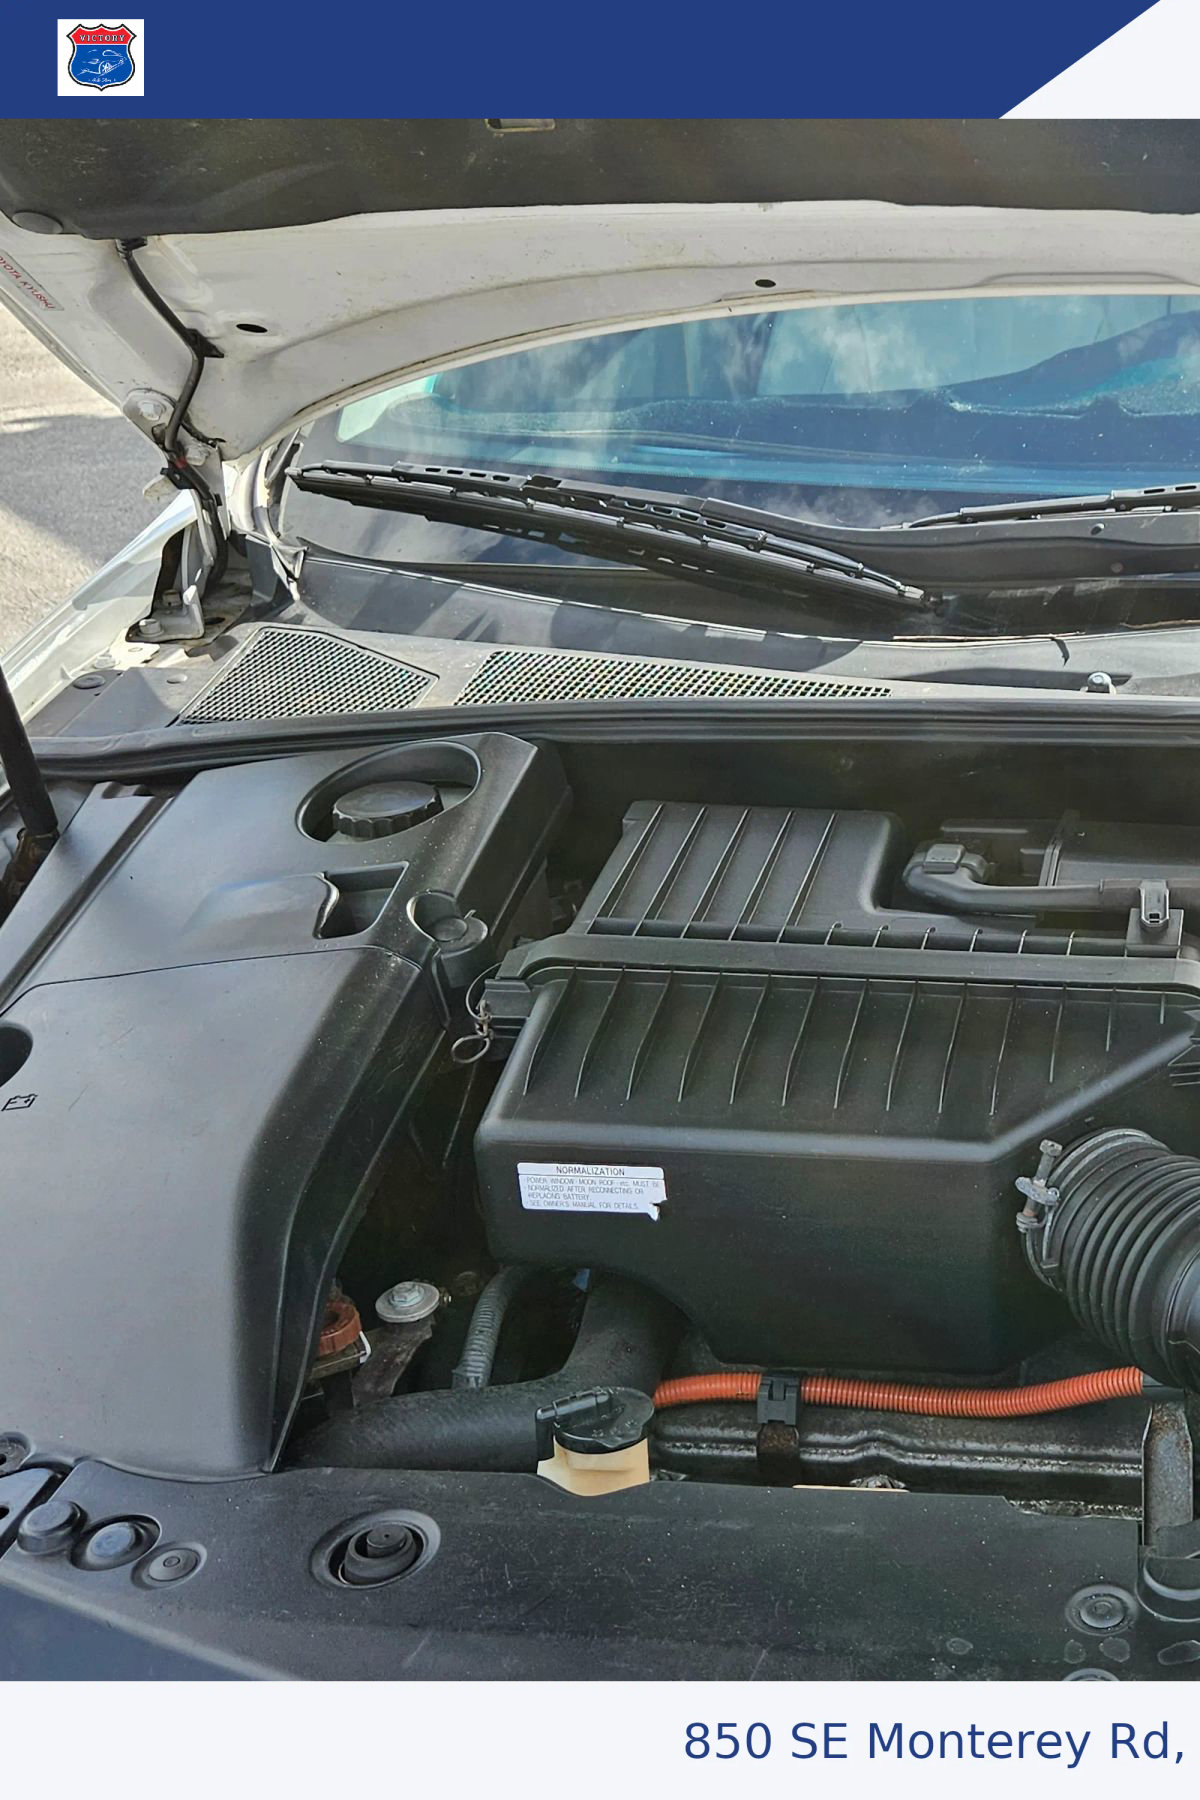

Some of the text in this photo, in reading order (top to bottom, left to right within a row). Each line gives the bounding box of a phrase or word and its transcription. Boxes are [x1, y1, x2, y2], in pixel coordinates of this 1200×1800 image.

[556, 1166, 625, 1176] NORMALIZATION
[528, 1184, 564, 1192] NORMALIZED
[567, 1185, 586, 1193] AFTER
